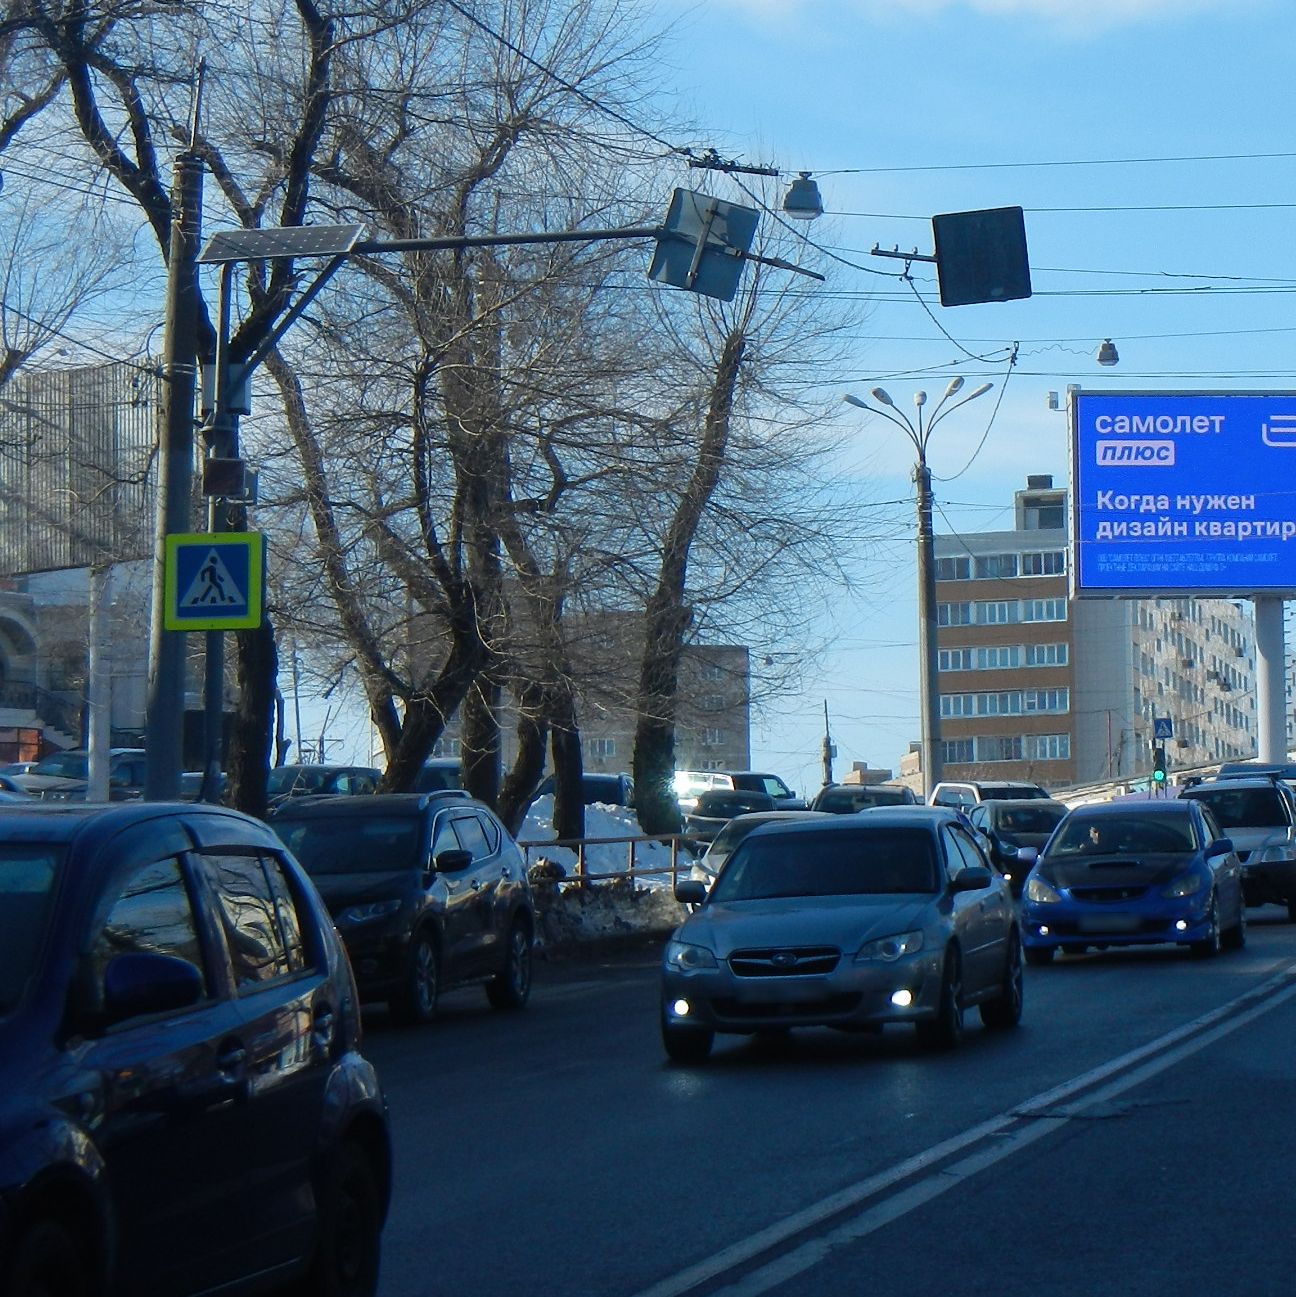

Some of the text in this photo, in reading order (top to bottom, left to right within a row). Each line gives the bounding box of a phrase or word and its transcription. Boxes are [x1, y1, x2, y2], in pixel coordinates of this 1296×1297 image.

[1095, 413, 1225, 434] самолет
[1101, 443, 1170, 462] плюс
[1096, 491, 1255, 514] Когда нужен
[1096, 516, 1188, 540] дизайн
